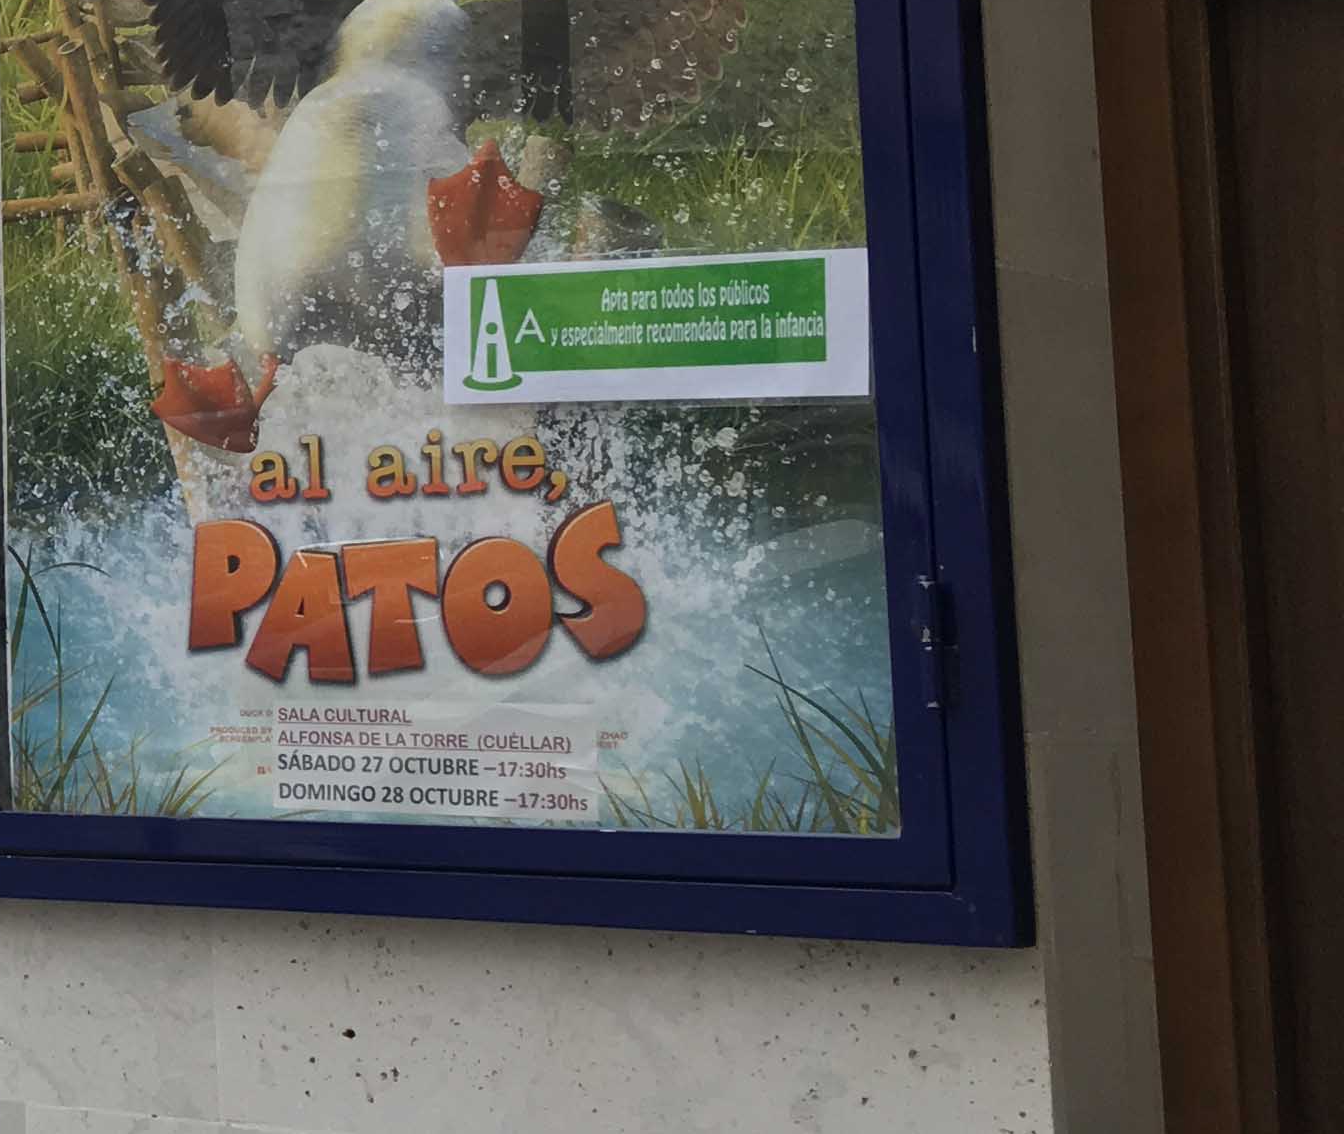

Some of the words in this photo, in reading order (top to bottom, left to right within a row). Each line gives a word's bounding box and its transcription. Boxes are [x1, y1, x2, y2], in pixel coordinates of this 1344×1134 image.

[601, 287, 628, 312] Apta
[631, 290, 657, 311] para
[661, 282, 694, 309] todos
[698, 281, 716, 307] los
[719, 279, 770, 306] públicos
[550, 327, 558, 347] y
[561, 319, 643, 347] especialmente
[646, 316, 726, 343] recomendada
[730, 318, 757, 340] para
[761, 312, 772, 339] la
[775, 311, 824, 338] infancia
[249, 433, 329, 502] al
[366, 428, 569, 502] aire,
[188, 499, 649, 686] PATOS
[278, 707, 320, 722] SALA
[324, 708, 412, 724] CULTURAL
[278, 730, 354, 746] ALFONSA
[359, 732, 381, 747] DE
[385, 733, 407, 747] LA
[410, 733, 469, 749] TORRE
[477, 732, 572, 753] (CUÉLLAR)
[278, 749, 355, 772] SÁBADO
[361, 756, 383, 773] 27
[389, 756, 479, 776] OCTUBRE
[279, 783, 376, 803] DOMINGO
[381, 786, 404, 804] 28
[409, 786, 499, 807] OCTUBRE
